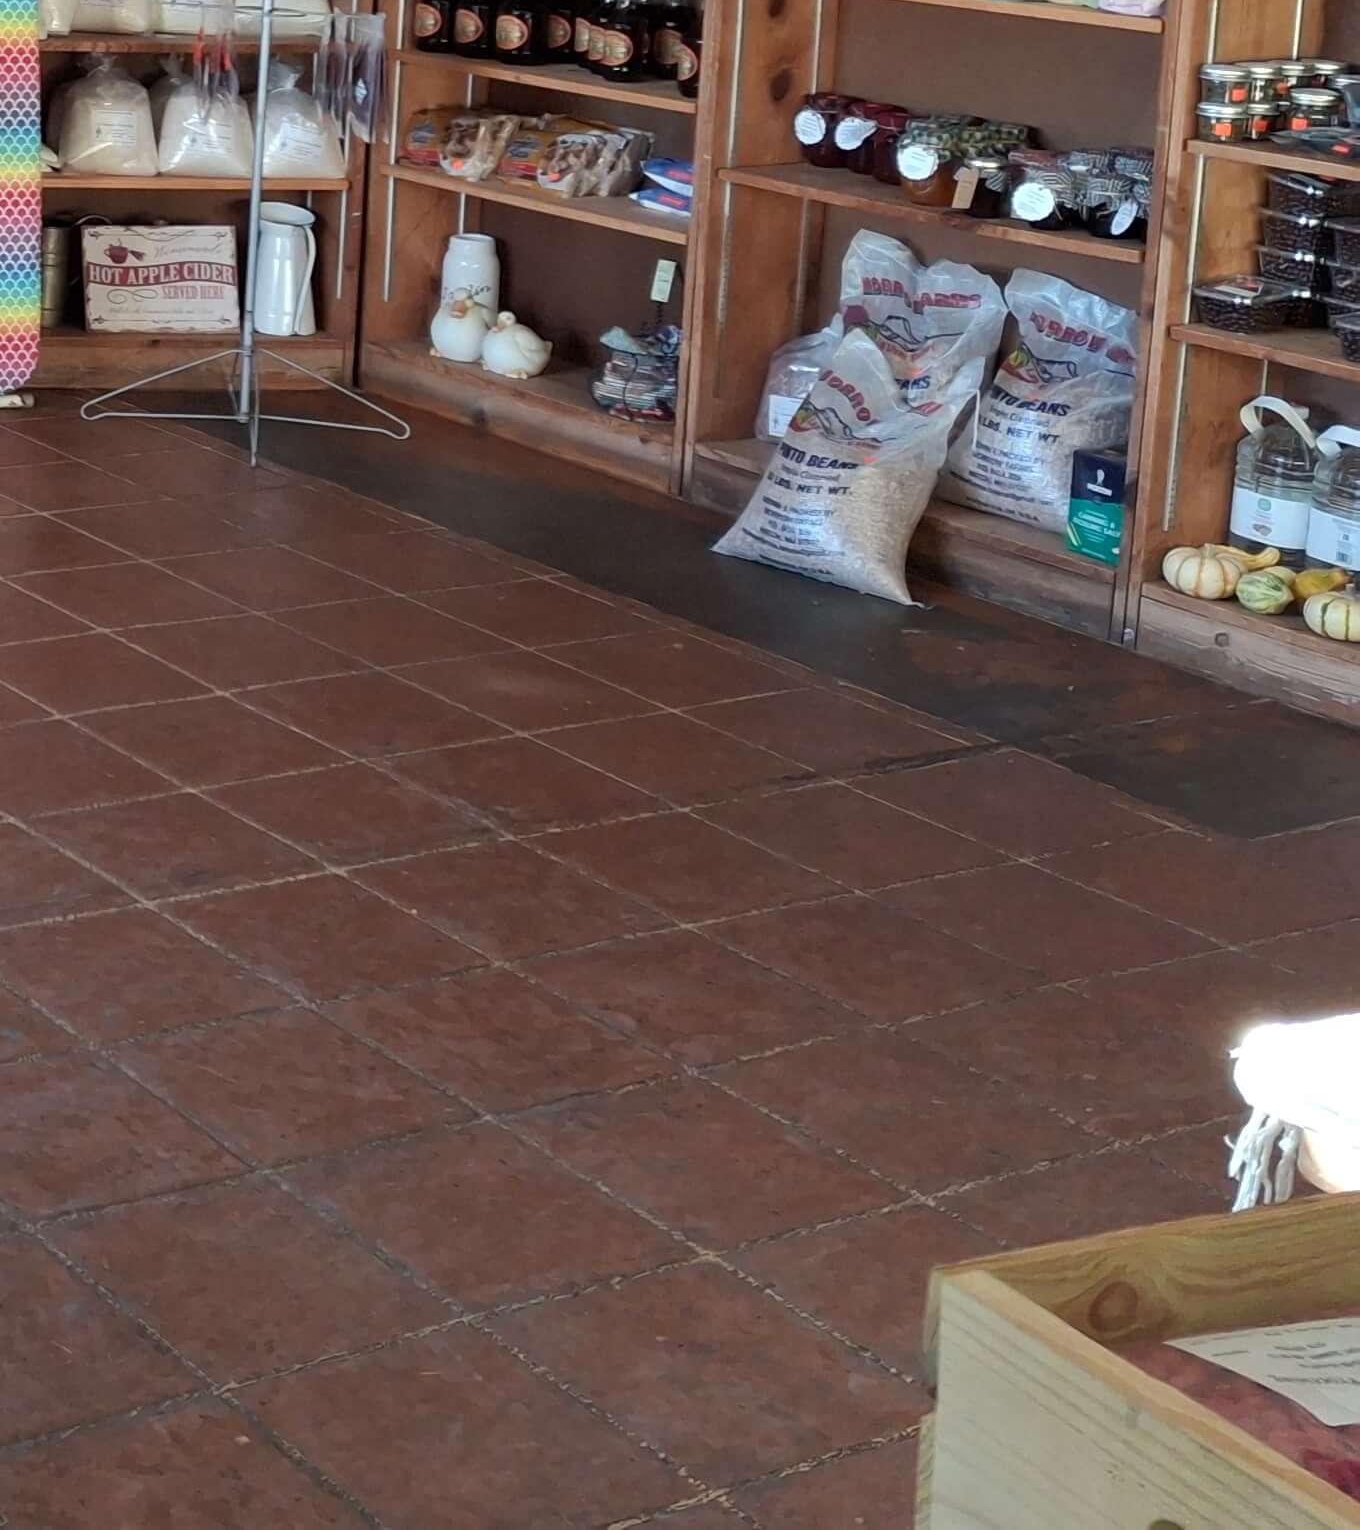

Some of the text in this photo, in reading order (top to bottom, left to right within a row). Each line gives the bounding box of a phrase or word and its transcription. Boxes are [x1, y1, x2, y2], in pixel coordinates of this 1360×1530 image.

[89, 262, 234, 285] HOT APPLE CIDER
[161, 286, 225, 300] SERVED HERE
[1006, 427, 1032, 442] NET
[796, 484, 823, 495] NET
[828, 486, 854, 496] WT.
